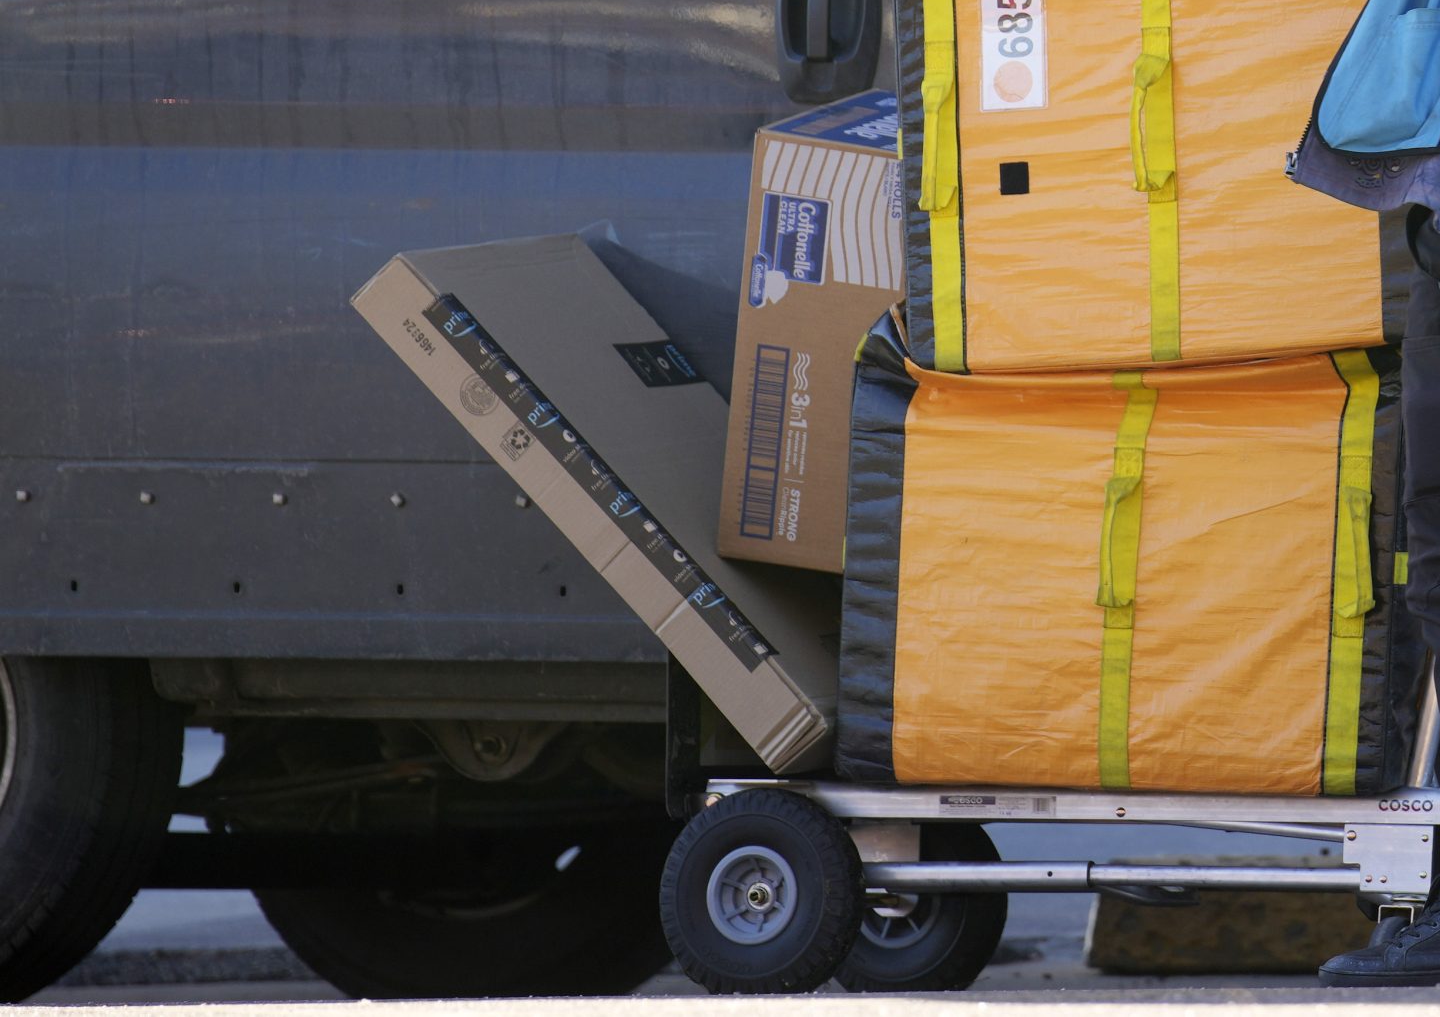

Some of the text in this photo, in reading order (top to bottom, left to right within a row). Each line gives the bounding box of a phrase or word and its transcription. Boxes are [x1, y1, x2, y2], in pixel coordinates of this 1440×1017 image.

[891, 181, 902, 219] ROLLS
[777, 201, 788, 234] CLEAN
[786, 202, 798, 232] ULTRA
[793, 202, 817, 279] Cottonelle
[443, 310, 471, 335] pri
[527, 401, 553, 426] pri
[789, 392, 811, 429] 3in1
[609, 491, 636, 515] pri
[786, 488, 801, 542] STRONG
[1378, 799, 1434, 812] COSCO
